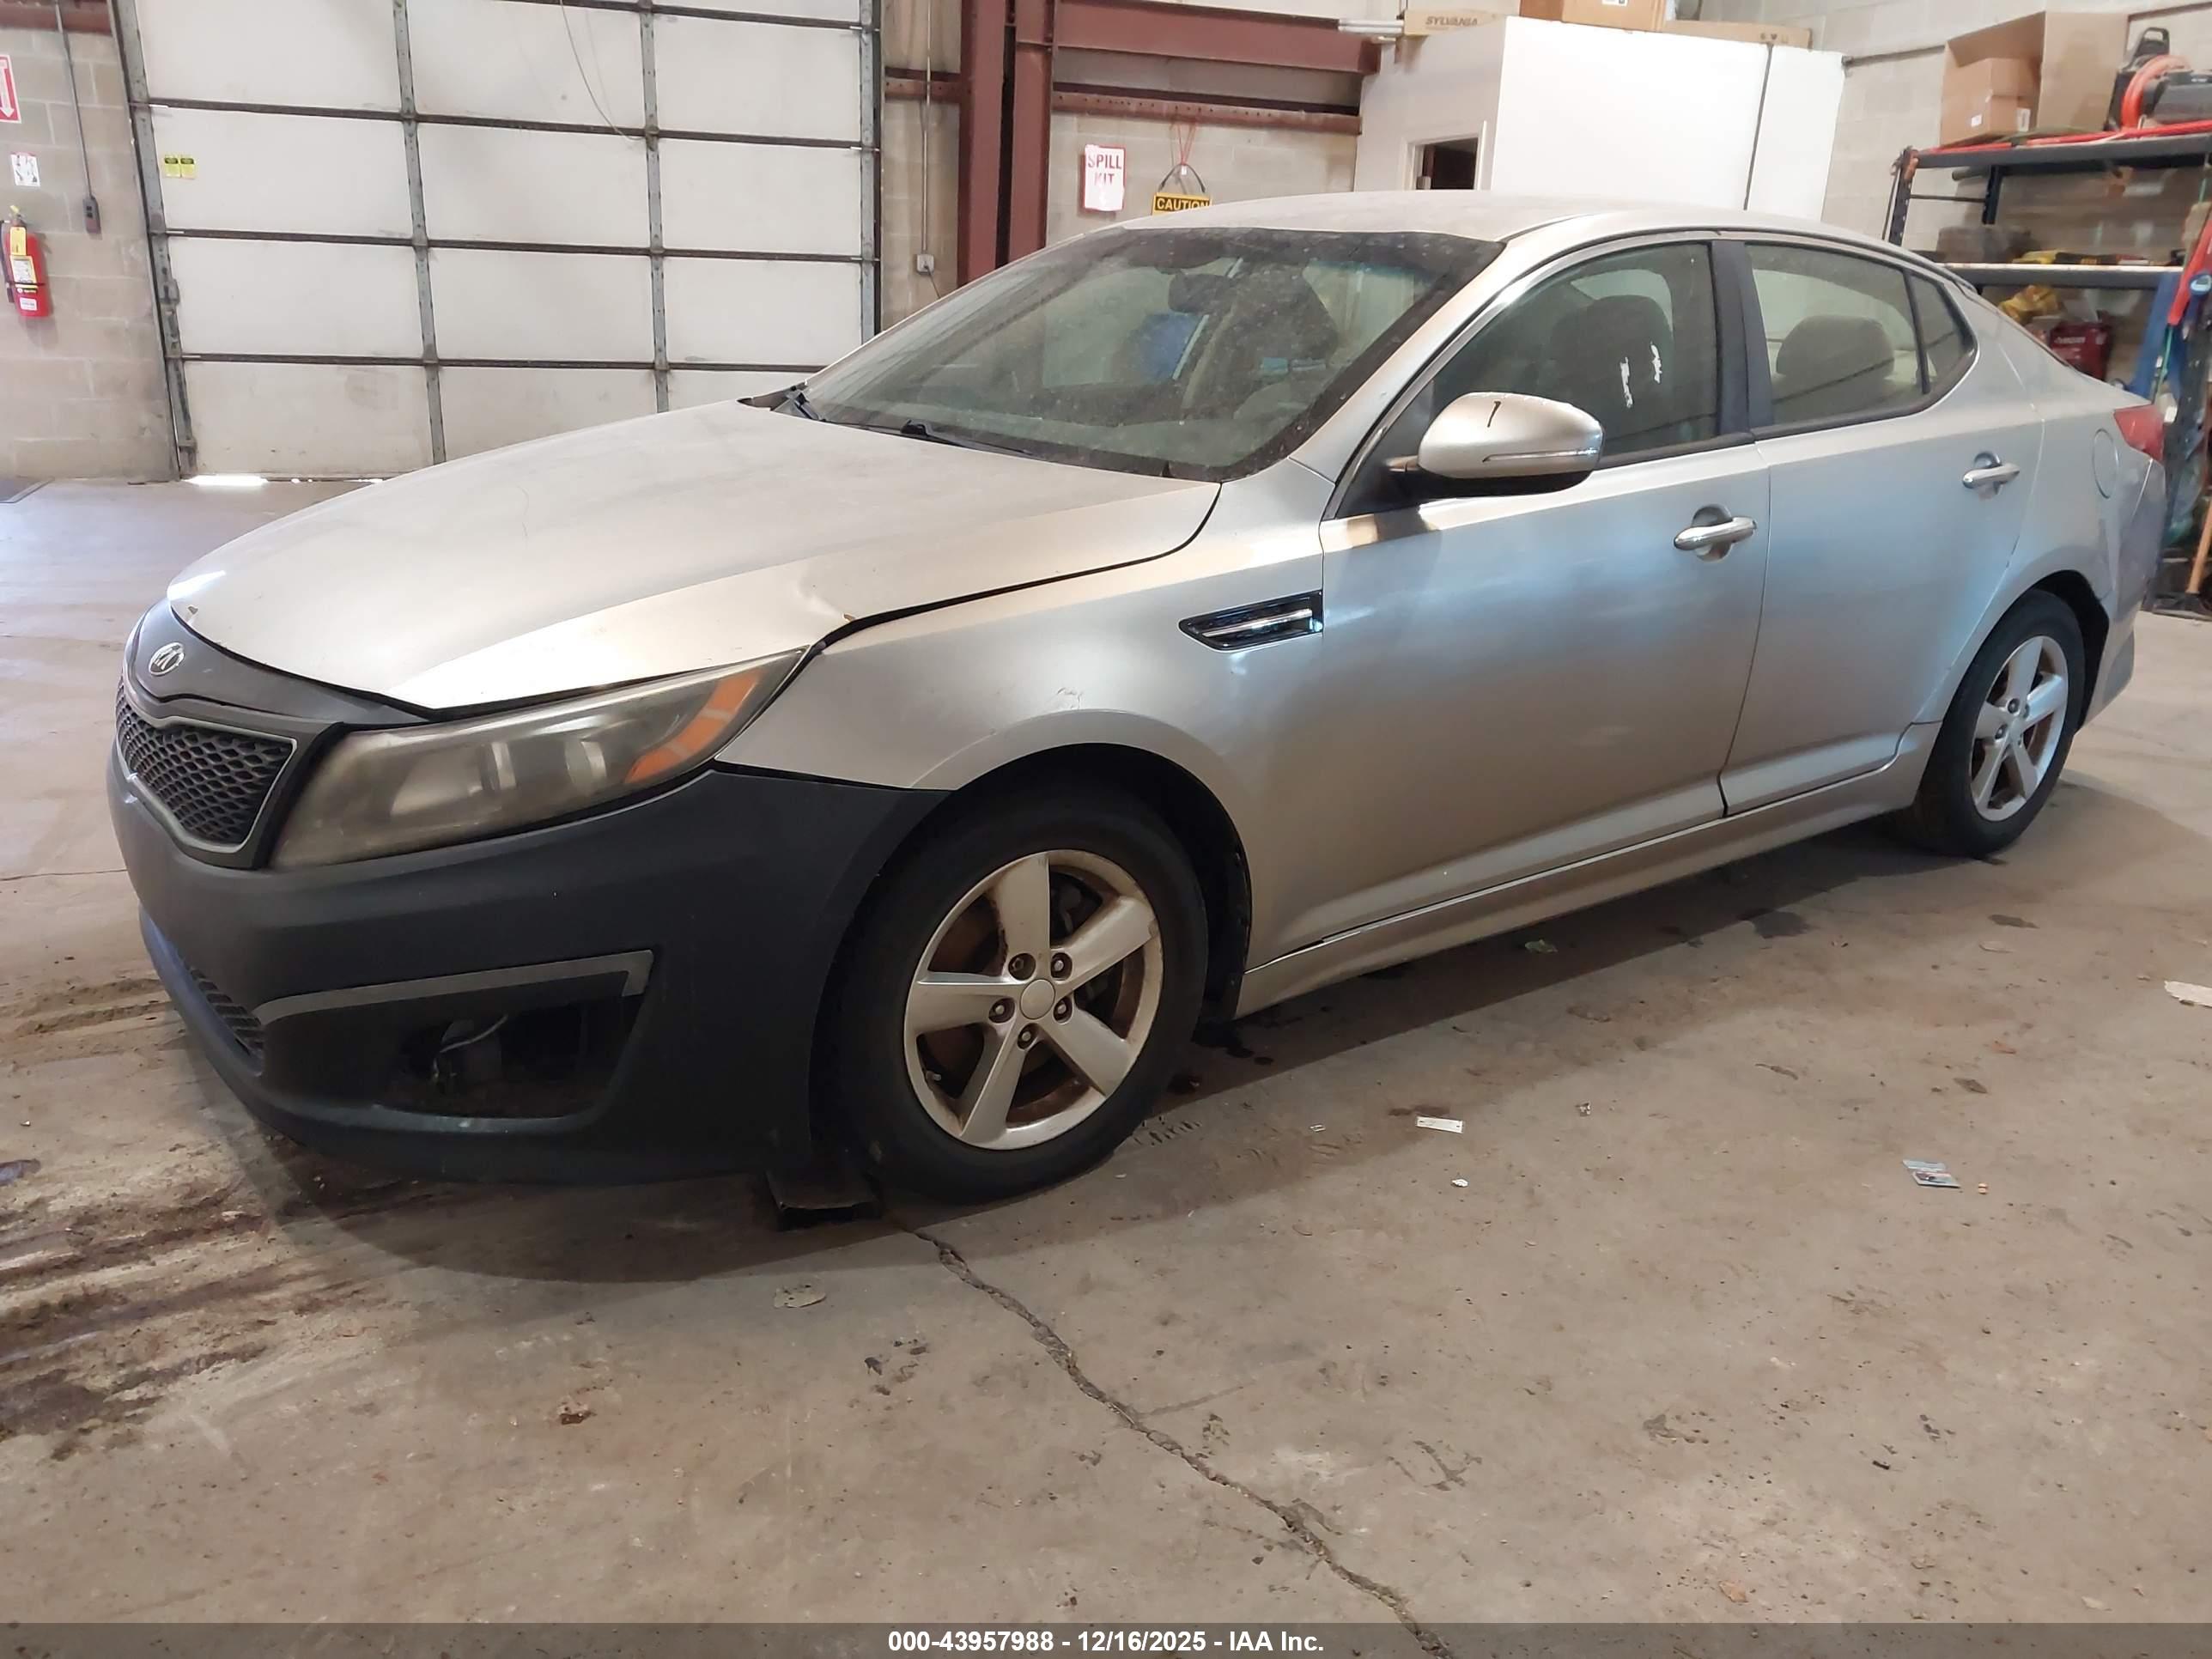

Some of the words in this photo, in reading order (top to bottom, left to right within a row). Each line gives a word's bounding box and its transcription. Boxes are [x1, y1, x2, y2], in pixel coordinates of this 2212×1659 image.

[1425, 15, 1478, 27] SYLVANIA
[1087, 154, 1122, 170] SPILL
[1094, 172, 1115, 185] KIT
